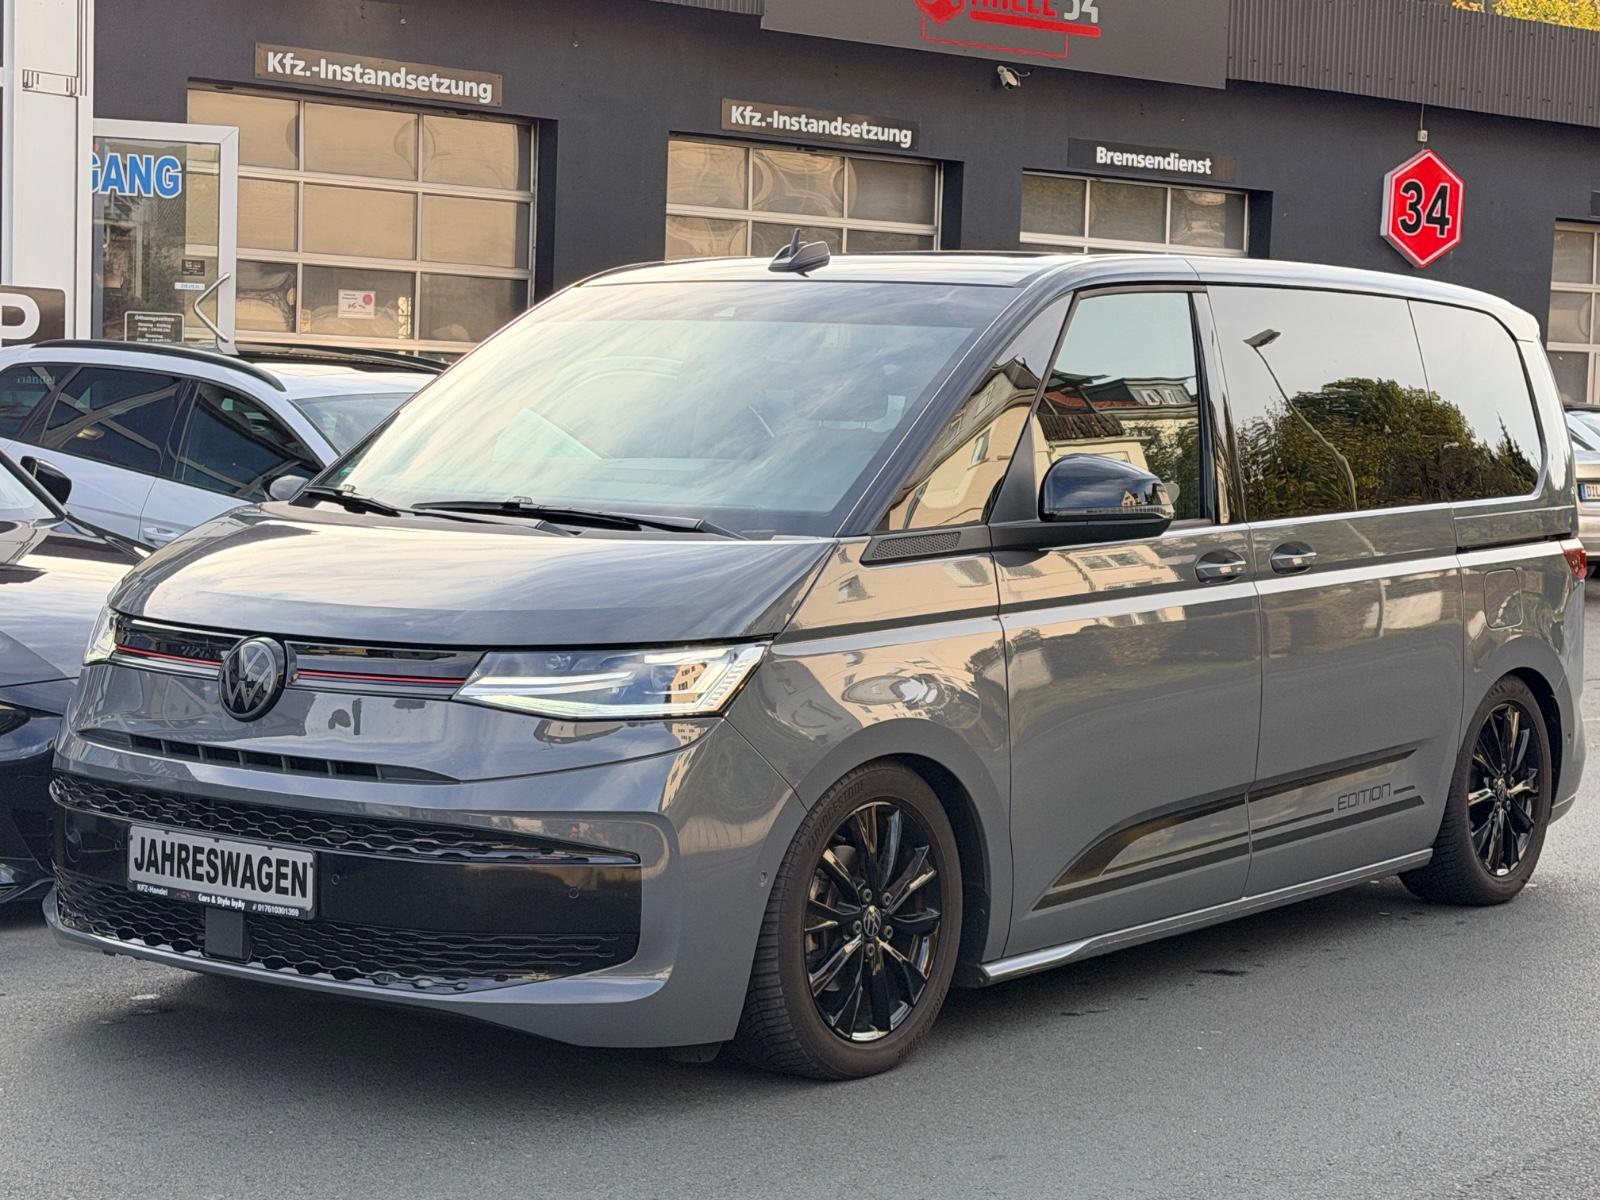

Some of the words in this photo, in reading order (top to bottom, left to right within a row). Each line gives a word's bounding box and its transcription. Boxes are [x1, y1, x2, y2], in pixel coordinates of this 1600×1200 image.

[267, 51, 492, 103] Kfz.-Instandsetzung
[731, 105, 912, 148] Kfz.-Instandsetzung
[1096, 146, 1211, 174] Bremsendienst
[1398, 179, 1450, 238] 34
[1338, 783, 1391, 811] EDITION
[134, 836, 308, 898] JAHRESWAGEN
